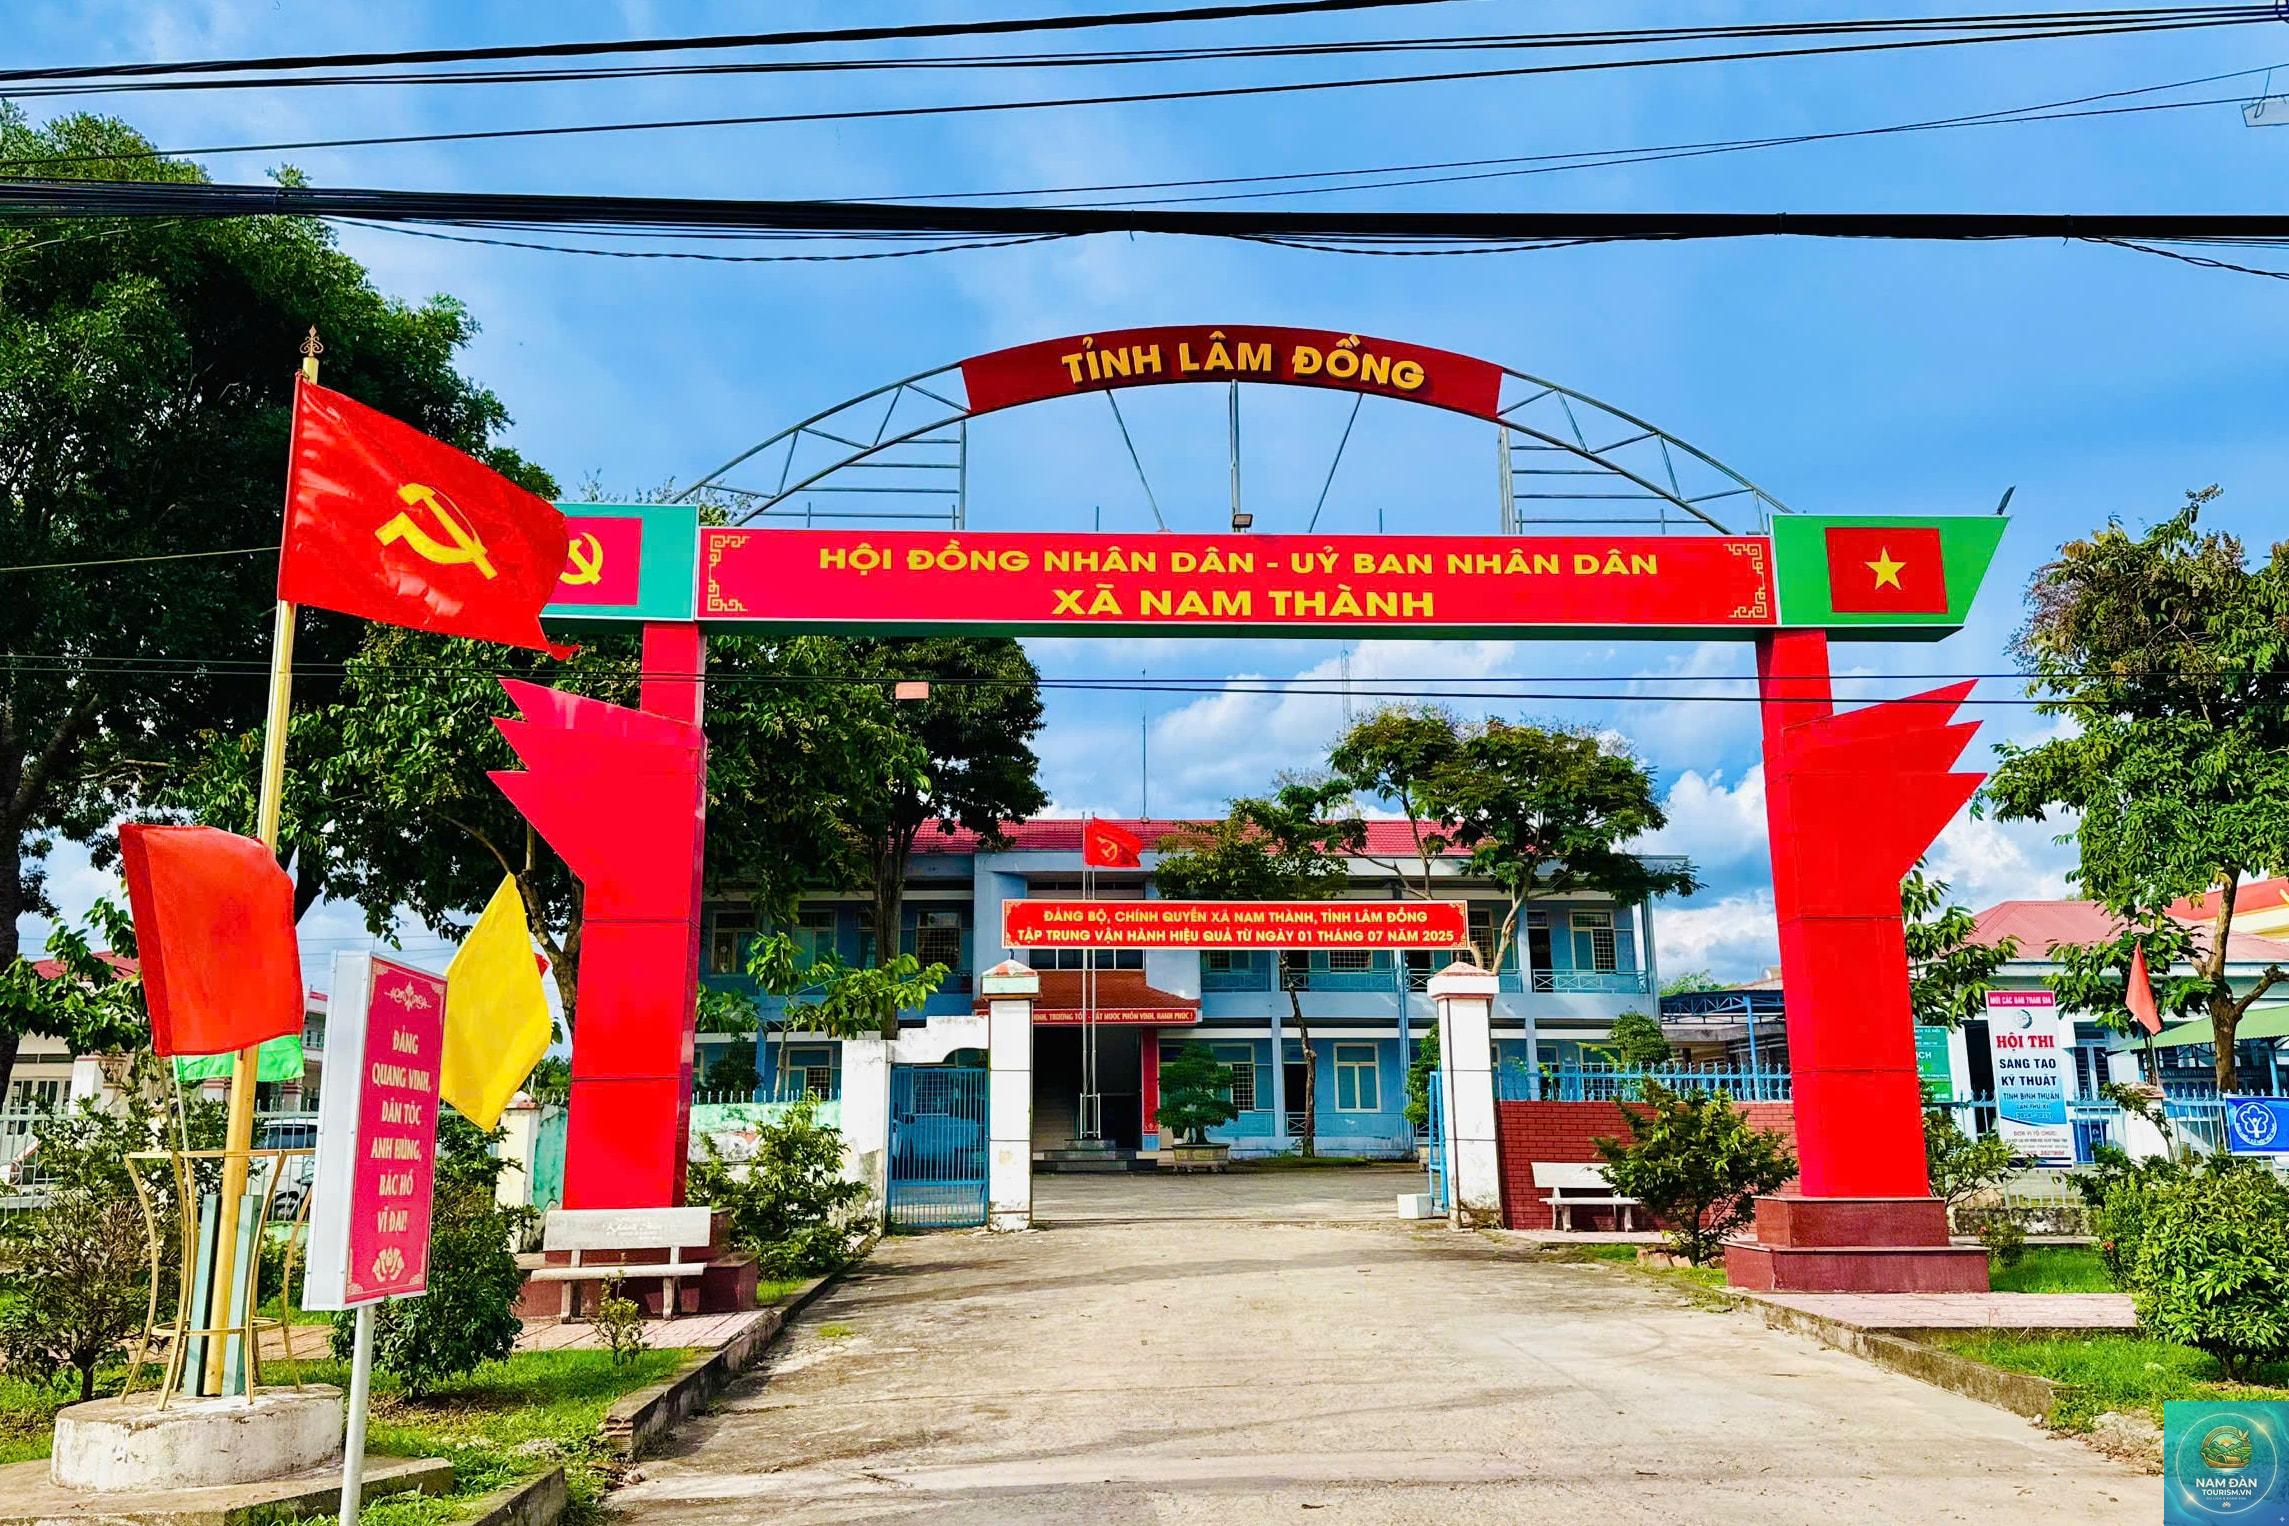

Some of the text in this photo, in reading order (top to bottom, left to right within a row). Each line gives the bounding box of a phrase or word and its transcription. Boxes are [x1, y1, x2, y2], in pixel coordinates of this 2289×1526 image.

[1061, 330, 1426, 391] TỈNH LÂM ĐỒNG
[819, 543, 893, 577] HỘI
[906, 539, 1030, 573] ĐỒNG
[1043, 546, 1157, 573] NHÂN
[1171, 545, 1255, 574] DÂN
[1291, 545, 1337, 575] UỶ
[1353, 553, 1433, 575] BAN
[1447, 548, 1560, 575] NHÂN
[1573, 548, 1658, 576] DÂN
[1051, 583, 1434, 617] XÃ NAM THÀNH
[1043, 906, 1427, 925] ĐẢNG BỘ, CHÍNH QUYỀN XÃ NAM THÀNH, TỈNH LÂM ĐỒNG
[1018, 926, 1454, 945] TẬP TRUNG VẬN HÀNH HIỆU QUẢ TỪ NGÀY 01 THÁNG 07 NĂM 2025
[393, 1025, 419, 1054] ĐẢNG
[1996, 1031, 2055, 1051] HỘI THI
[372, 1062, 431, 1093] QUANG VINH,
[381, 1097, 422, 1129] DÂN TỘC
[371, 1137, 393, 1159] ANH
[379, 1169, 398, 1196] BÁC
[377, 1205, 388, 1233] VĨ
